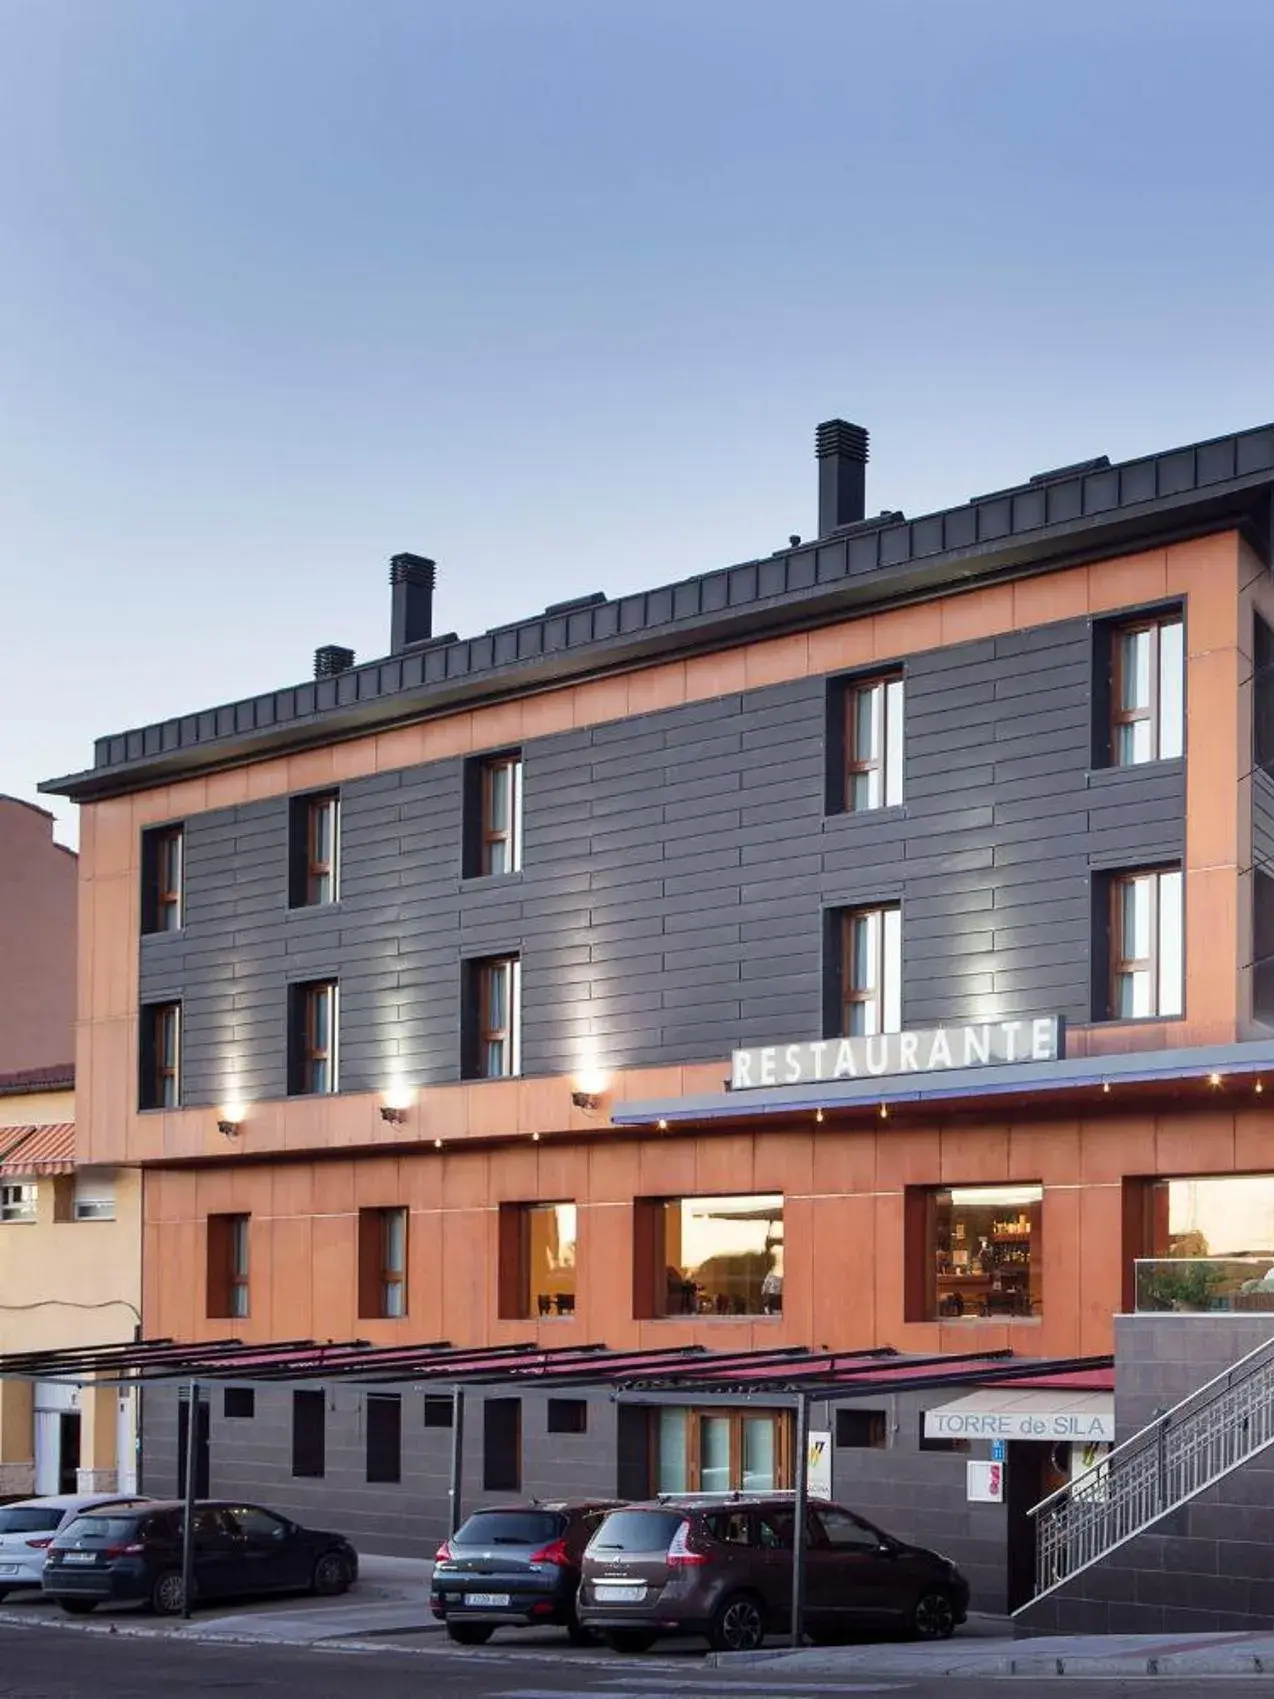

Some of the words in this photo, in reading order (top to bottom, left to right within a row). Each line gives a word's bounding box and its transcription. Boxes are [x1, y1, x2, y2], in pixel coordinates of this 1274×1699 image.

[732, 1017, 1052, 1088] RESTAURANTE
[935, 1412, 1011, 1434] TORRE
[1019, 1415, 1047, 1435] de
[1052, 1414, 1105, 1435] SILA
